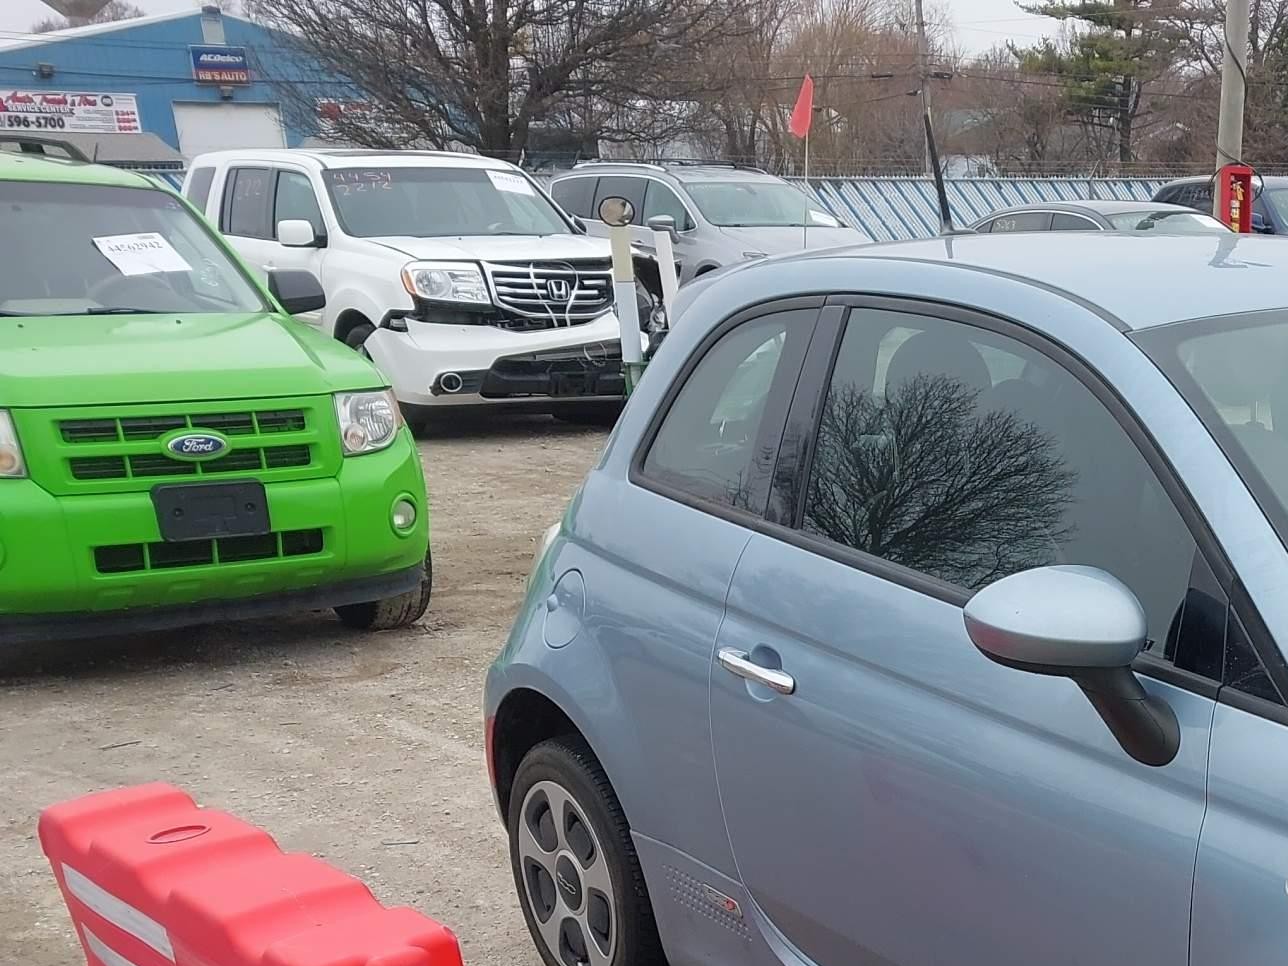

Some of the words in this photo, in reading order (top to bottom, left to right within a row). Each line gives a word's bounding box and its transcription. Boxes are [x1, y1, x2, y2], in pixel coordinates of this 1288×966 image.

[221, 71, 247, 81] AUTO
[7, 103, 40, 113] SERVICE
[7, 115, 65, 129] 596-5700
[182, 438, 214, 452] Ford
